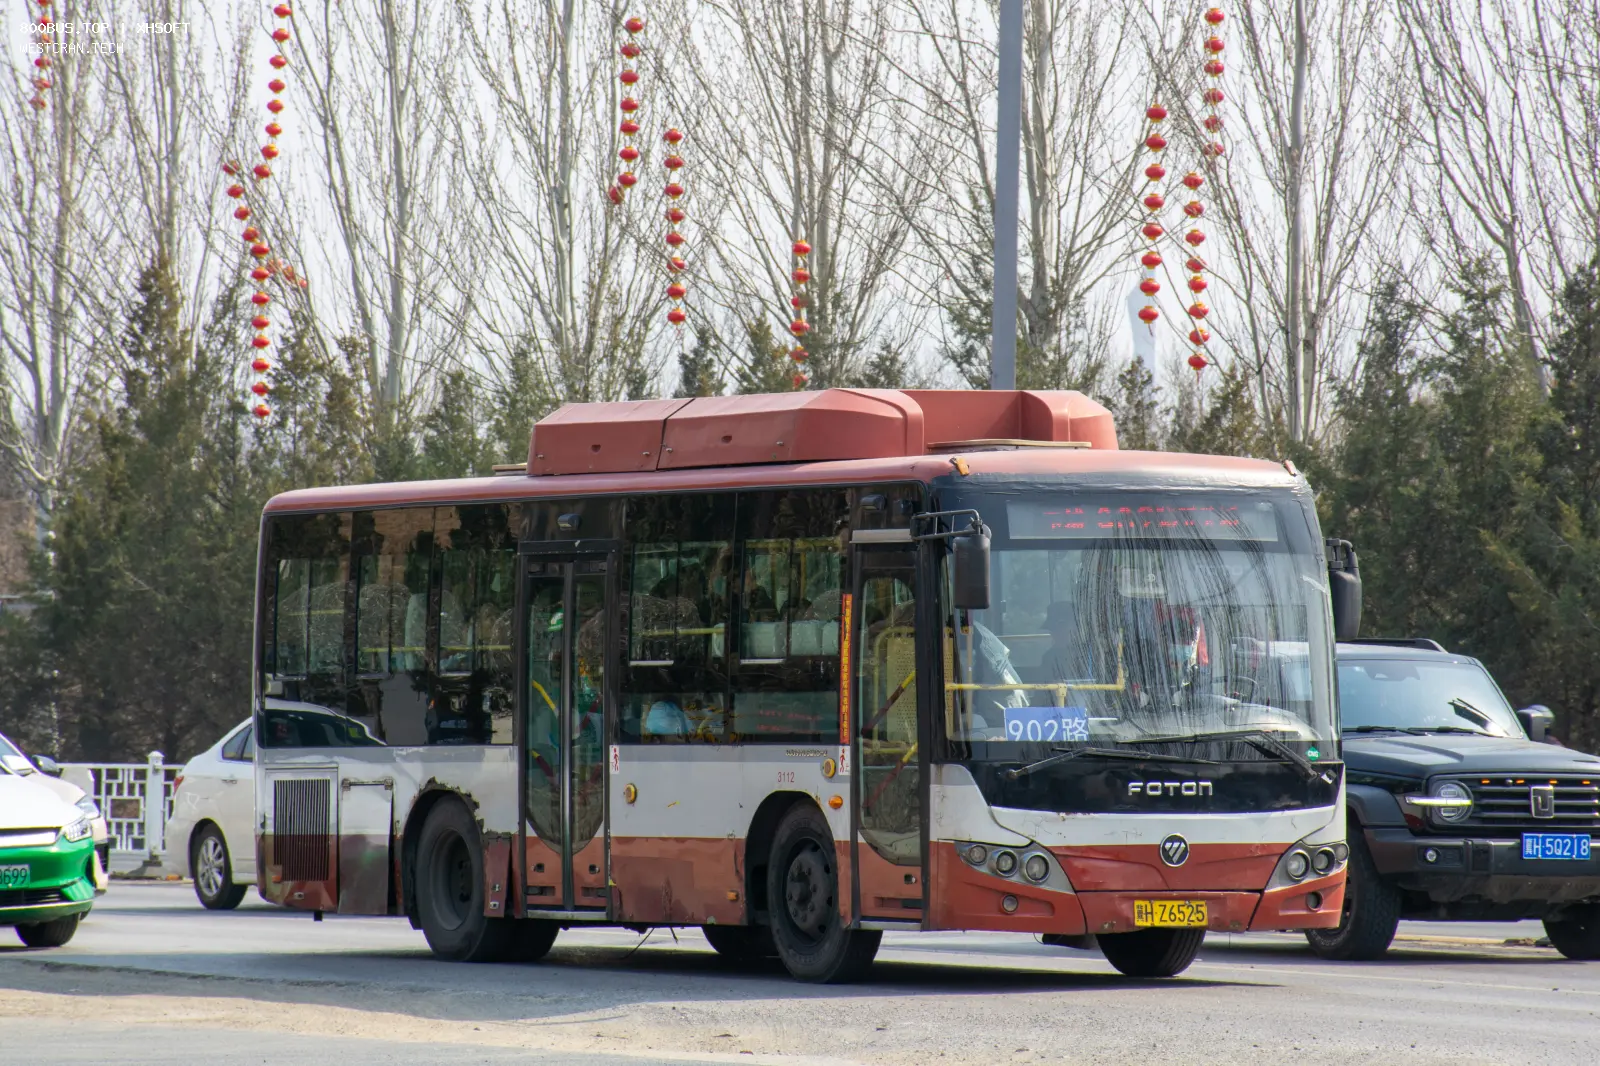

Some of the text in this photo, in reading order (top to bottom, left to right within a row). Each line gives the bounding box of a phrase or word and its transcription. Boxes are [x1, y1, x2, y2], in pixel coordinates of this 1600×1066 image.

[1008, 717, 1089, 742] 902路
[777, 771, 795, 783] 3112
[1127, 781, 1213, 796] FOTON
